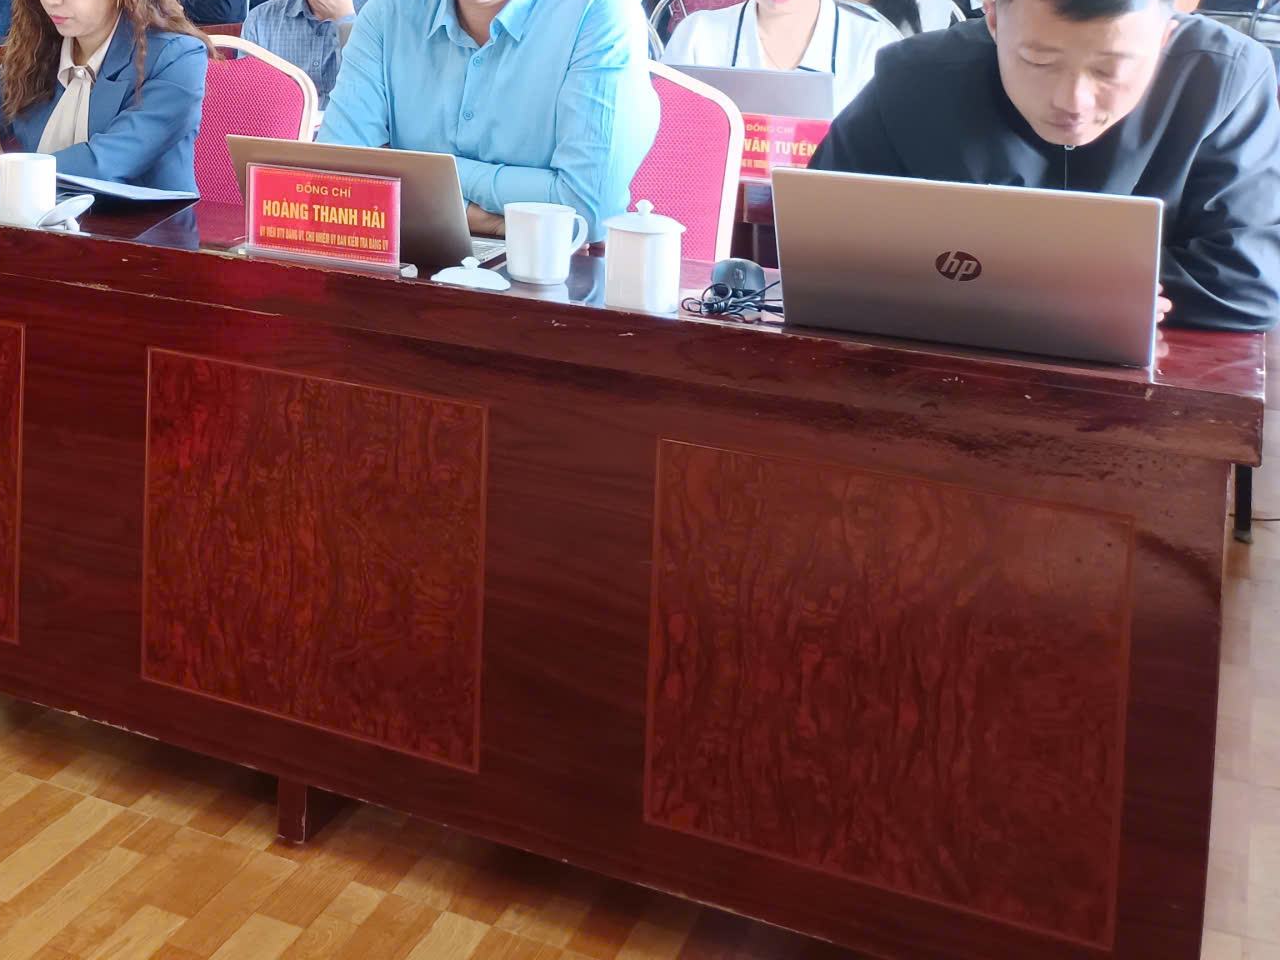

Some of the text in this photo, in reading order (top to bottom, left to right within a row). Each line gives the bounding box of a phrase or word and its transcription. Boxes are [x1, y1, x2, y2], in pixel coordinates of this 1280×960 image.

[743, 136, 770, 153] VĂN
[296, 182, 352, 199] ĐỒNG CHÍ
[263, 198, 386, 229] HOÀNG THANH HẢI
[938, 251, 980, 281] hp
